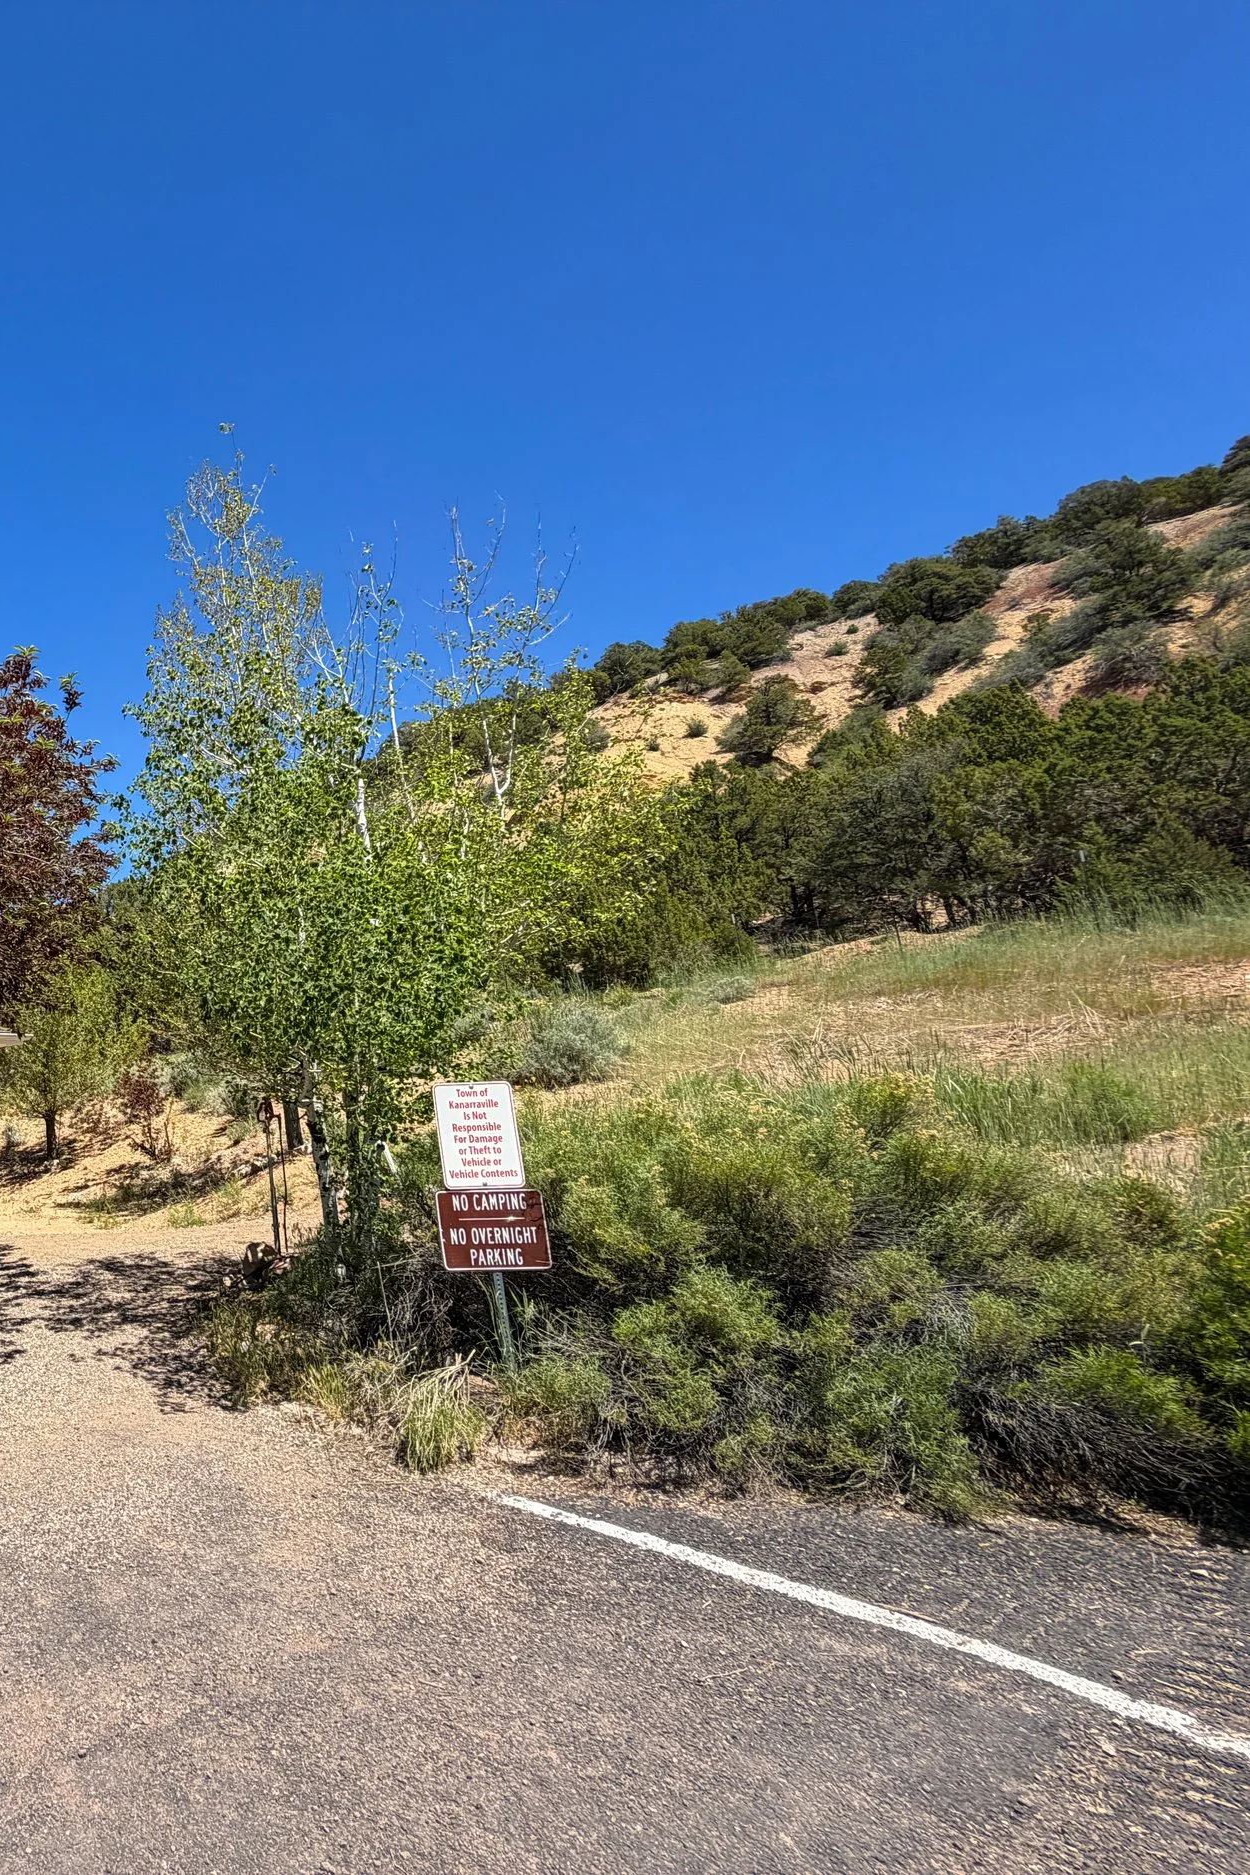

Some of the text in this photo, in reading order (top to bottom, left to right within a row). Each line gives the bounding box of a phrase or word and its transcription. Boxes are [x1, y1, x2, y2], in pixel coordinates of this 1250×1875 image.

[456, 1088, 488, 1097] Town of
[449, 1099, 499, 1109] Kanarraville
[464, 1111, 487, 1120] Is Not
[452, 1122, 501, 1133] Responsible
[454, 1135, 502, 1144] For Damage
[468, 1146, 491, 1154] Theft
[461, 1157, 491, 1166] Vehicle
[449, 1169, 518, 1179] Vehicle Contents
[452, 1193, 526, 1211] NO CAMPING
[450, 1227, 536, 1245] NO OVERNIGHT
[470, 1248, 523, 1266] PARKING
